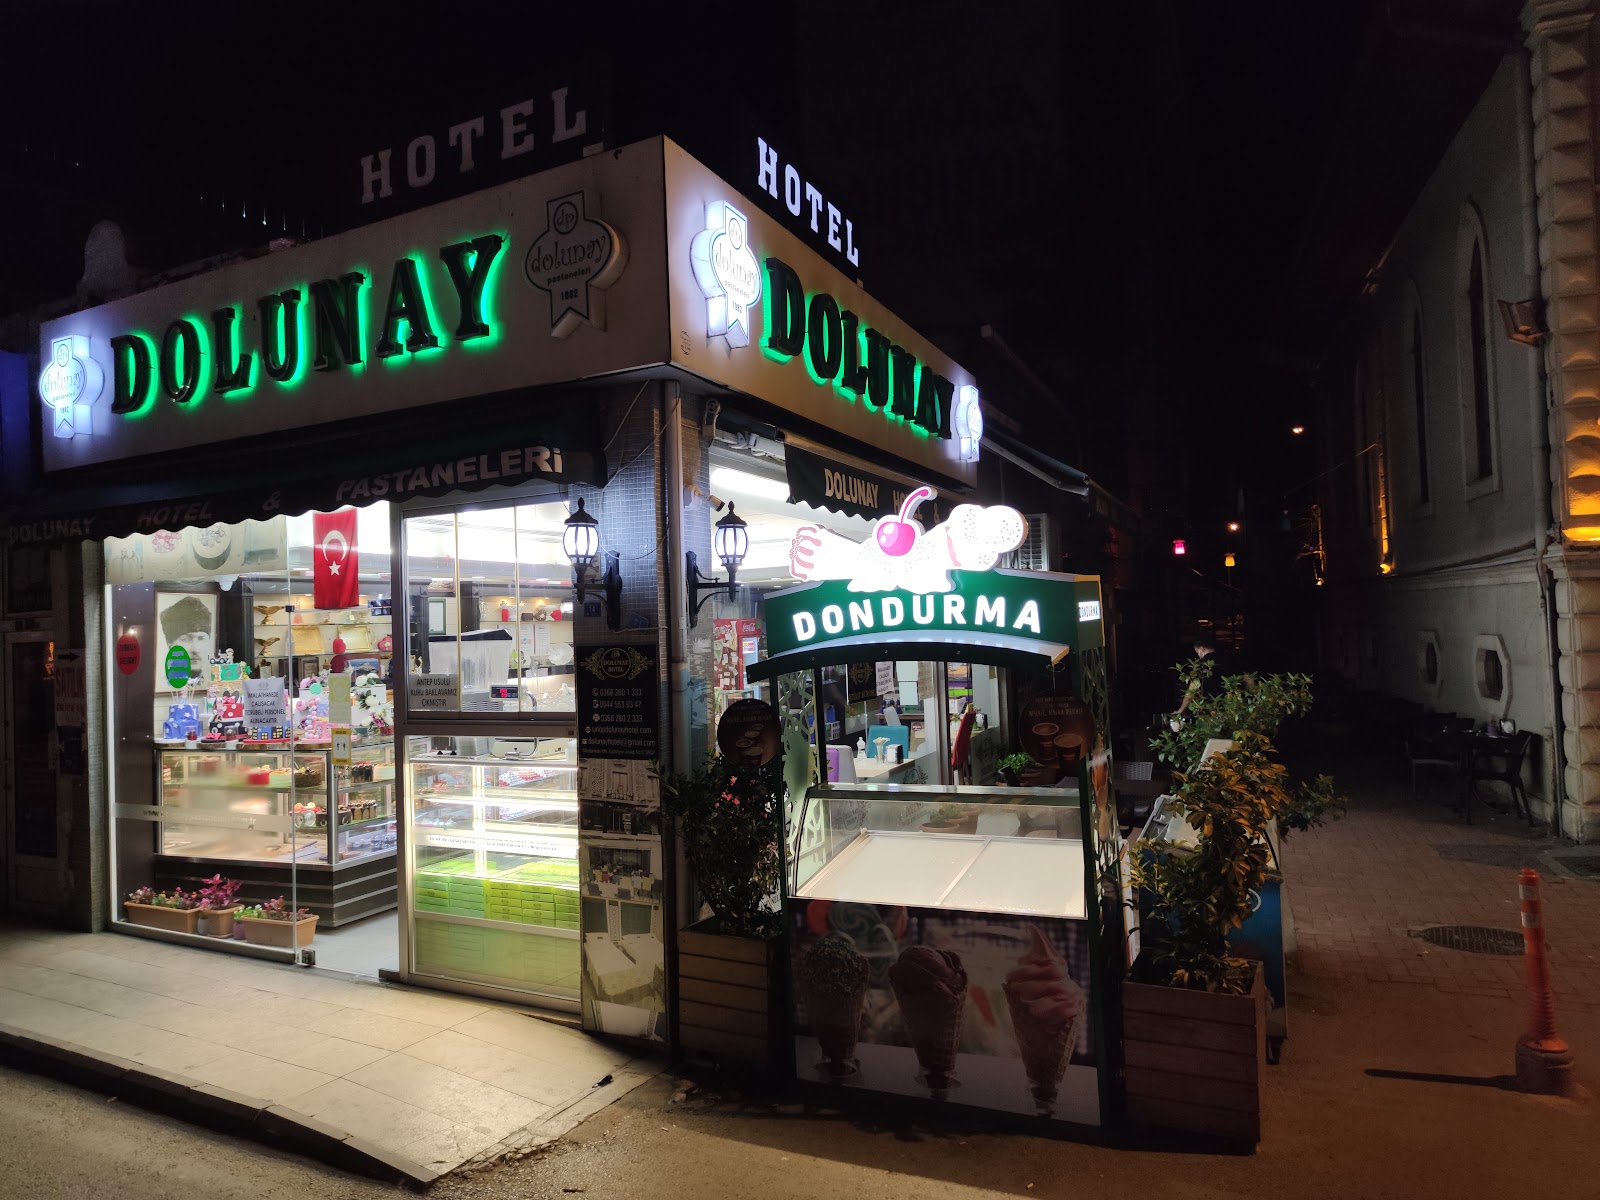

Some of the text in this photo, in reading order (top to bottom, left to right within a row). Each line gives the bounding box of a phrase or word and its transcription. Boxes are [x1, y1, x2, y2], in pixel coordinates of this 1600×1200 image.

[360, 86, 588, 203] HOTEL
[757, 137, 860, 268] HOTEL
[531, 235, 606, 273] dolunay
[111, 234, 504, 415] DOLUNAY
[763, 256, 955, 440] DOLUNAY
[8, 516, 97, 544] DOLUNAY
[136, 499, 213, 529] HOTEL
[262, 489, 281, 513] &
[824, 468, 879, 509] DOLUNAY
[892, 489, 923, 520] HOL
[792, 594, 1041, 641] DONDURMA
[416, 678, 433, 686] ANTEP
